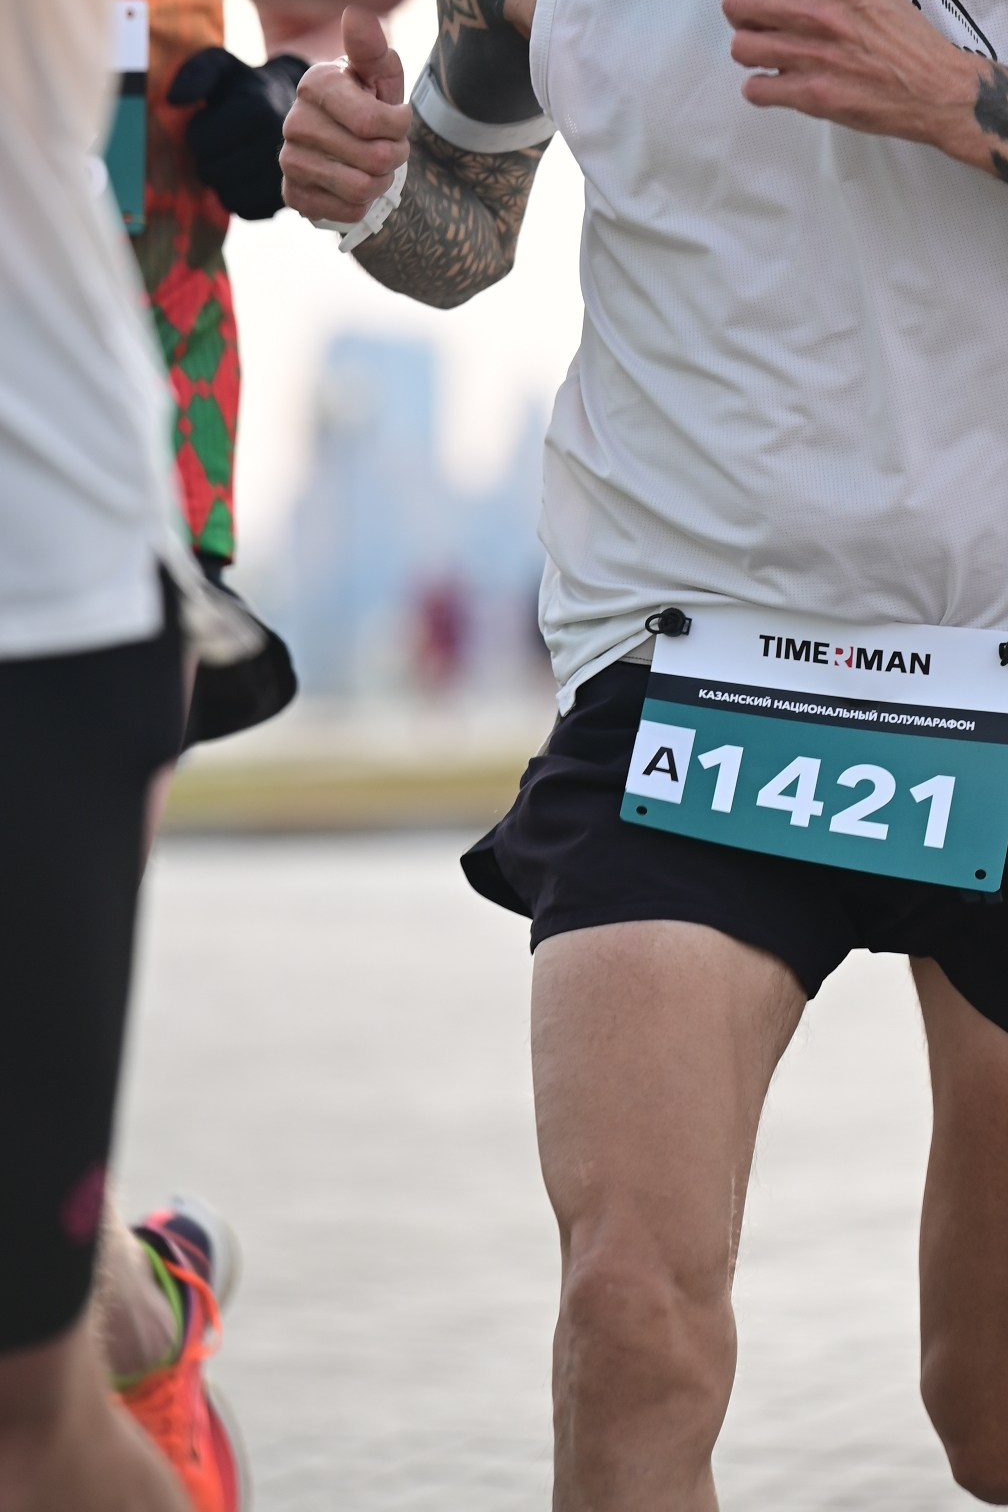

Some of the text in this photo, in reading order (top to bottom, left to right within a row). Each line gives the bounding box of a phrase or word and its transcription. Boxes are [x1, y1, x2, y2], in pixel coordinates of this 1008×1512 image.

[698, 688, 976, 732] КАЗАНСКИЙ НАЦИОНАЛЬНЫЙ ПОЛУМАРАФОН
[696, 744, 957, 849] 1421
